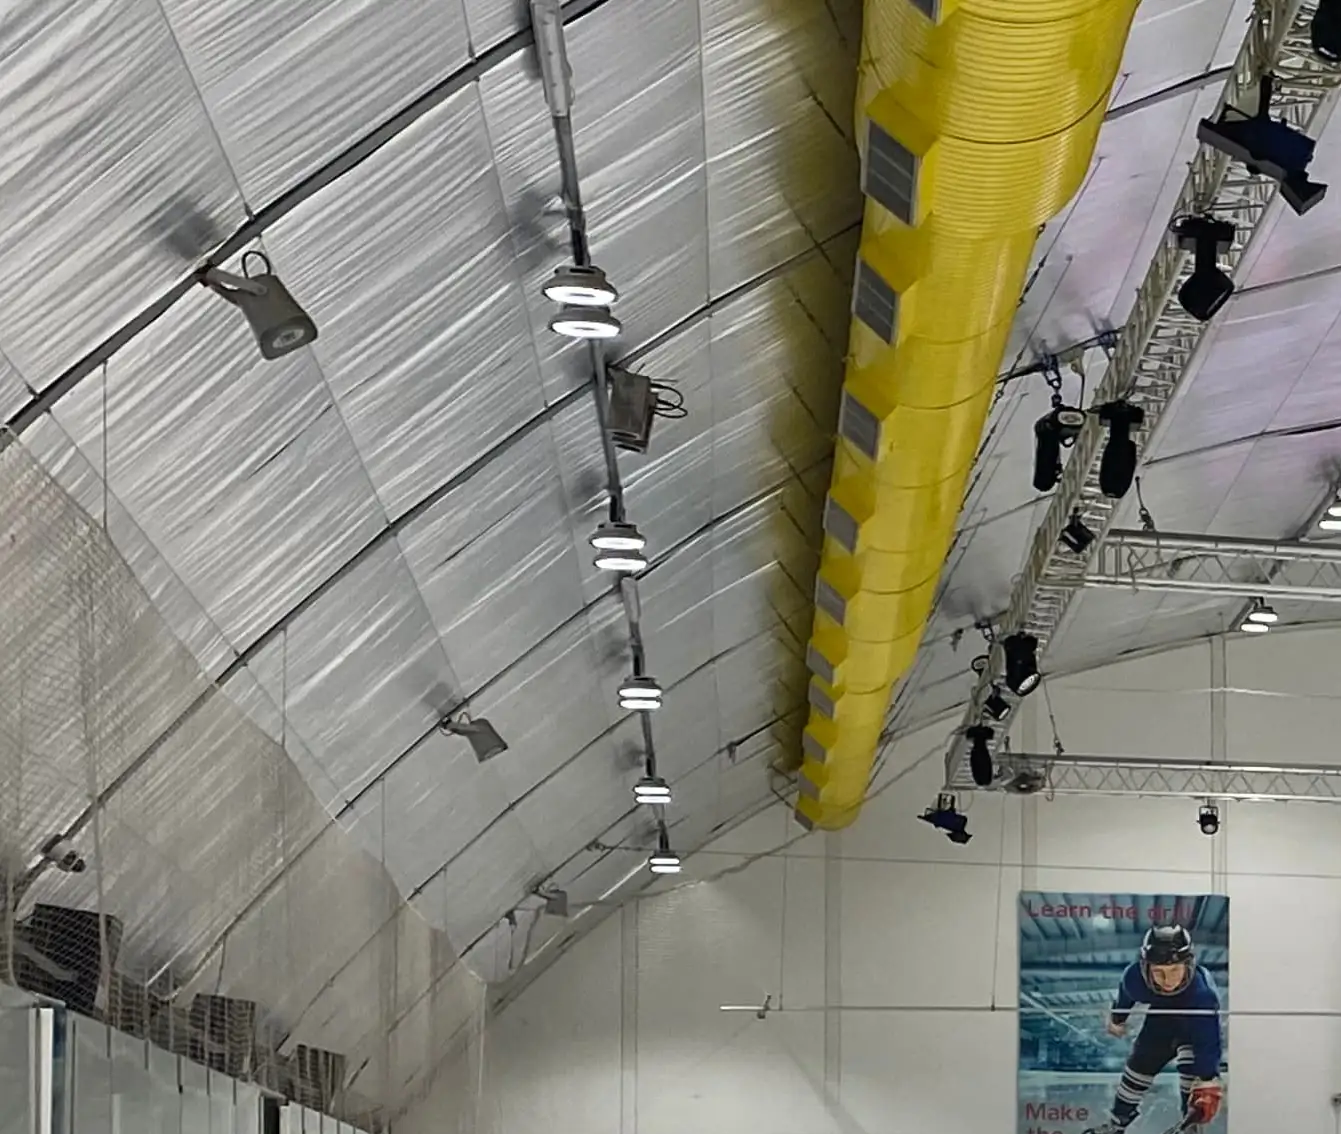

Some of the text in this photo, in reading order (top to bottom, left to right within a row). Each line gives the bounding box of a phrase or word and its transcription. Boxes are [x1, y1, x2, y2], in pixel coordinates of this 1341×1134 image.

[1028, 899, 1091, 919] Learn
[1101, 900, 1138, 920] the
[1026, 1103, 1089, 1121] Make
